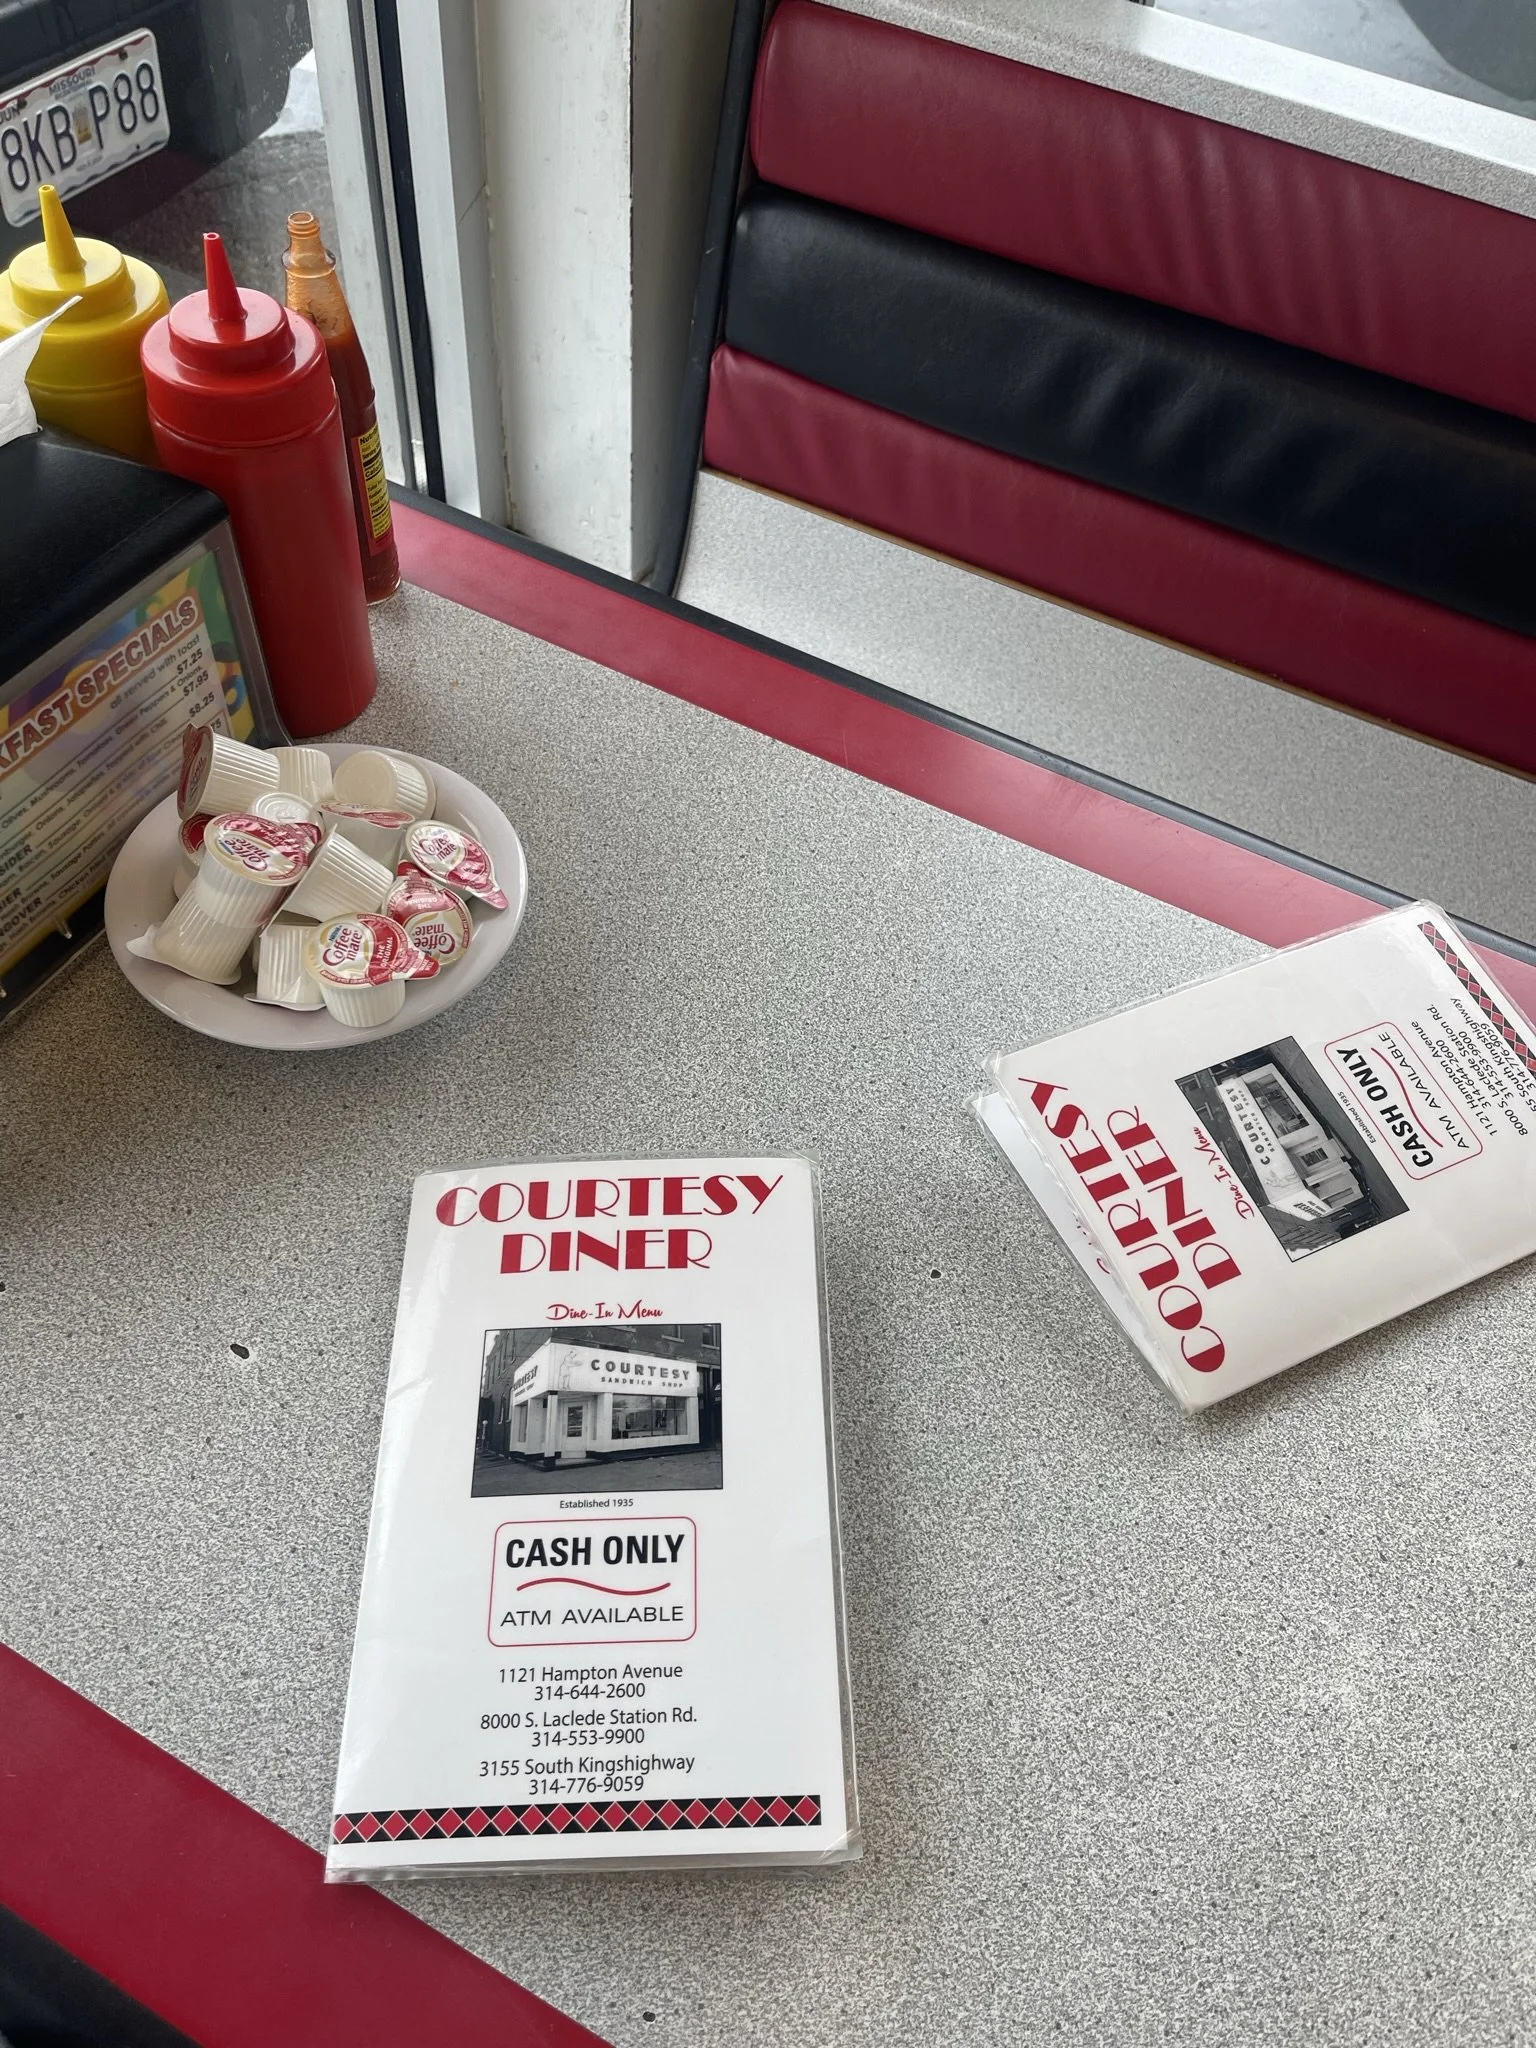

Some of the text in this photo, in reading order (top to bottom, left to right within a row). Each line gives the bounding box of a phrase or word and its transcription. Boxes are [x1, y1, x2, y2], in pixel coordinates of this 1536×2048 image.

[49, 66, 96, 95] MISSOURI
[1, 62, 160, 192] 8KB P88
[77, 599, 197, 703] SPECIALS
[157, 653, 177, 672] with
[177, 634, 201, 657] toast
[176, 647, 204, 676] $7.25
[182, 669, 209, 697] $7.95
[189, 691, 215, 718] $8.25
[224, 838, 268, 872] Coffee
[236, 837, 271, 860] mate
[419, 837, 451, 856] Coffee
[436, 842, 457, 860] mate
[346, 930, 363, 961] mate
[413, 933, 456, 955] Coffee
[414, 923, 444, 937] mate
[322, 927, 352, 967] Coffee
[376, 944, 386, 960] THE
[380, 936, 394, 968] ORIGINAL
[1426, 1003, 1444, 1021] Rd.
[1441, 1020, 1471, 1058] Station
[1449, 998, 1508, 1066] Kingshighway
[1458, 1030, 1515, 1100] 314-553-9900
[1480, 1022, 1536, 1092] 314-776-9059
[1411, 1019, 1499, 1137] 1121 Hampton Avenue
[1435, 1039, 1492, 1110] 314-644-2600
[1468, 1057, 1500, 1099] Laclede
[1503, 1066, 1530, 1097] South
[1378, 1031, 1470, 1150] ATM AVAILABLE
[1336, 1048, 1434, 1168] CASH ONLY
[1337, 1091, 1377, 1144] Established 1935
[1504, 1108, 1529, 1136] 8000
[1225, 1087, 1271, 1166] COURTESY
[1192, 1125, 1256, 1220] Dine-In Menu
[435, 1174, 784, 1227] COURTESY
[1106, 1104, 1242, 1290] DINER
[1017, 1076, 1226, 1374] COURTESY
[500, 1228, 713, 1274] DINER
[546, 1300, 664, 1321] Dine-In Menu
[590, 1359, 690, 1381] COURTESY
[600, 1376, 653, 1386] SANDWICH
[559, 1498, 634, 1509] Established 1935
[505, 1534, 685, 1568] CASH ONLY
[500, 1606, 684, 1627] ATM AVAILABLE
[499, 1664, 684, 1684] 1121 Hampton Avenue
[534, 1682, 646, 1701] 314-644-2600
[480, 1706, 698, 1729] 8000 S. Laclede Station Rd.
[531, 1728, 646, 1747] 314-553-9900
[479, 1753, 695, 1777] 3155 South Kingshighway
[528, 1775, 645, 1796] 314-776-9059
